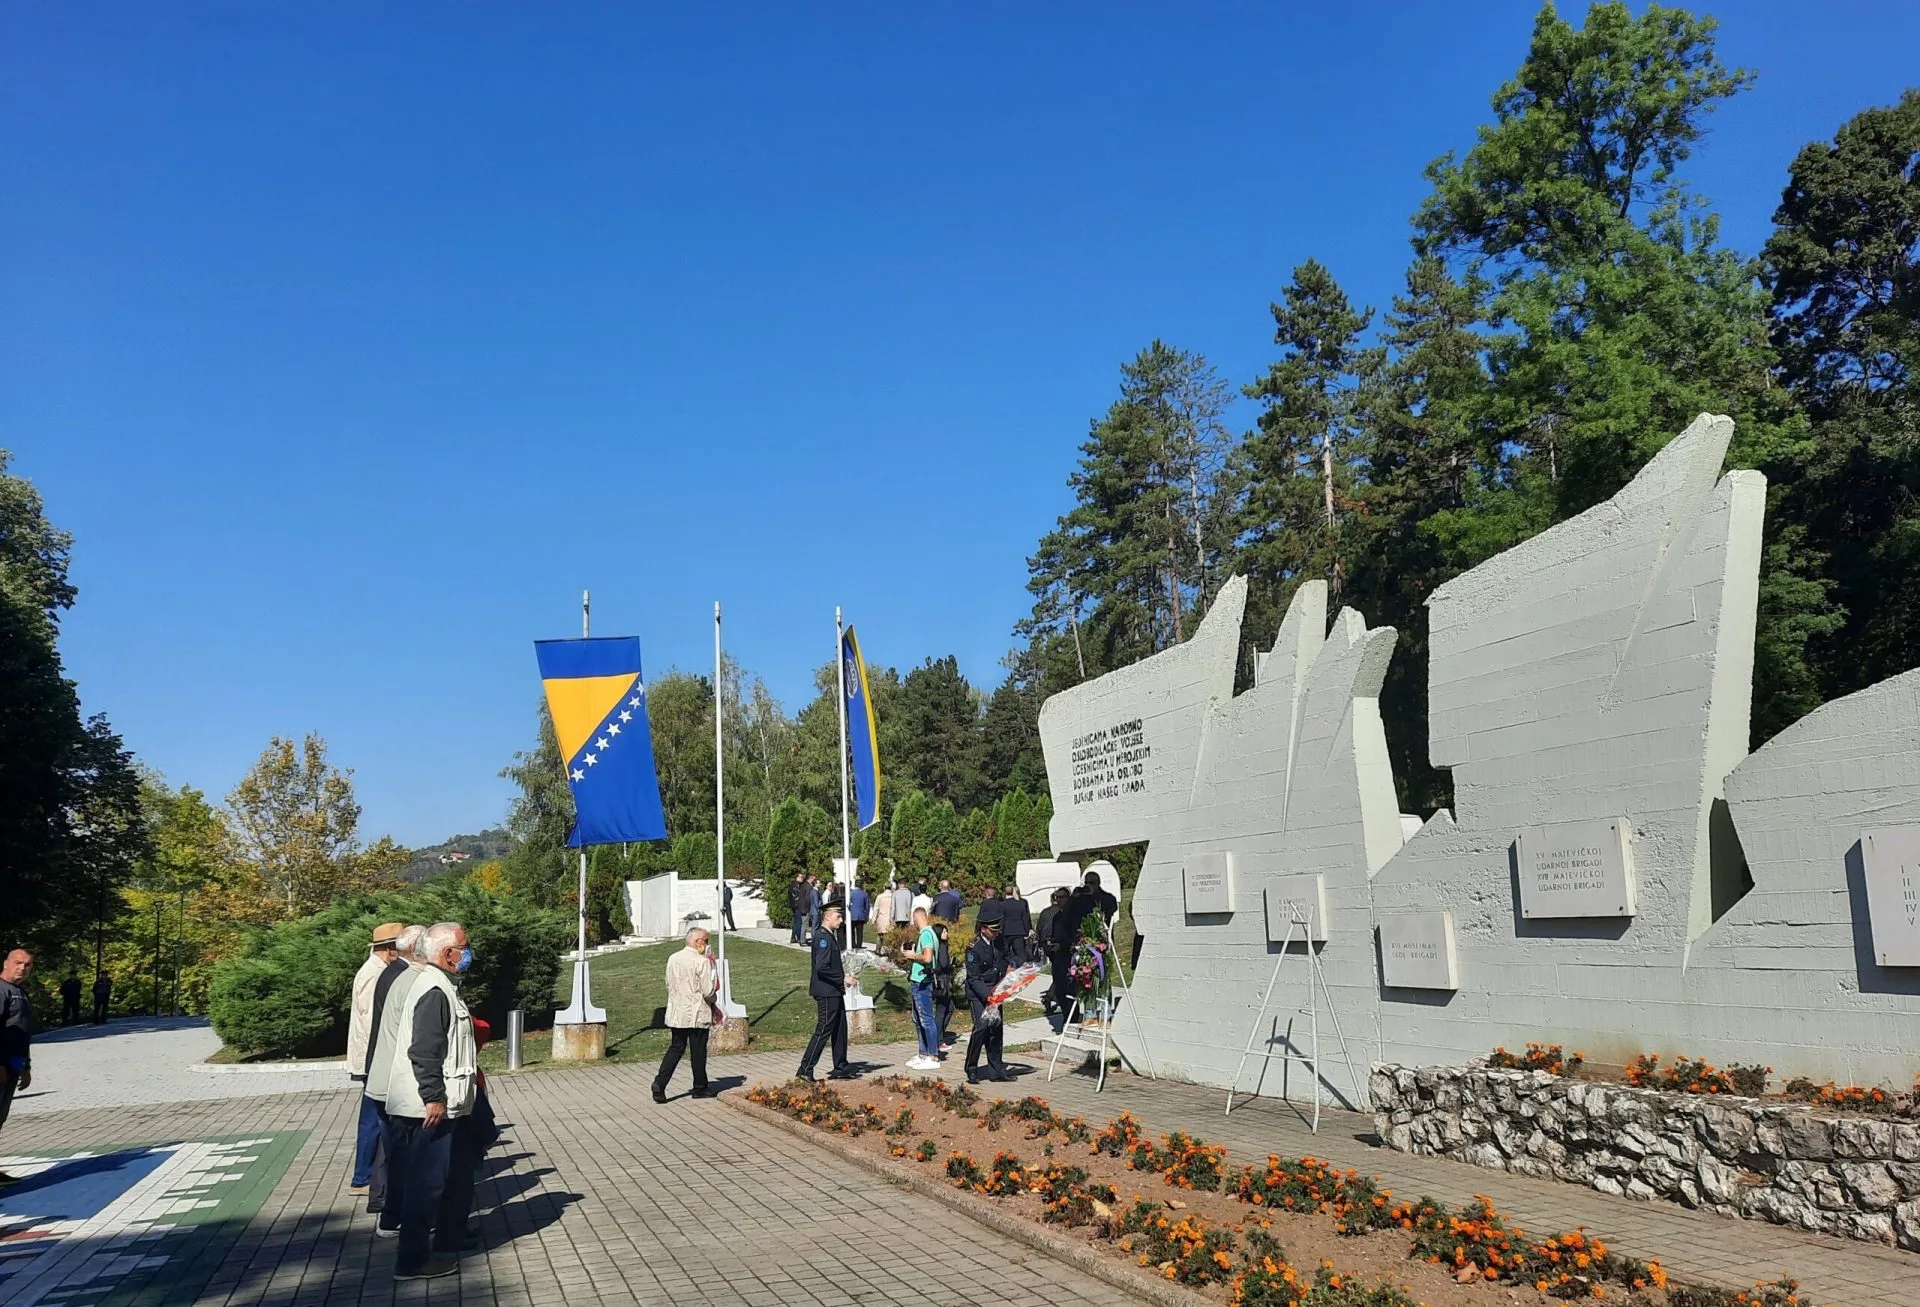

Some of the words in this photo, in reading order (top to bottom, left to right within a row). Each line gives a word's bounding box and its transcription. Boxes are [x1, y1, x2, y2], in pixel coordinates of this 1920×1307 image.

[1106, 770, 1115, 782] ZA
[1537, 860, 1569, 870] UDARNOJ
[1571, 859, 1602, 867] BRIGADI
[1538, 883, 1571, 892] UDARNOJ
[1573, 881, 1605, 890] BRIGADI
[1902, 877, 1910, 887] II
[1904, 890, 1916, 900] III
[1905, 903, 1917, 913] IV
[1907, 916, 1915, 925] V
